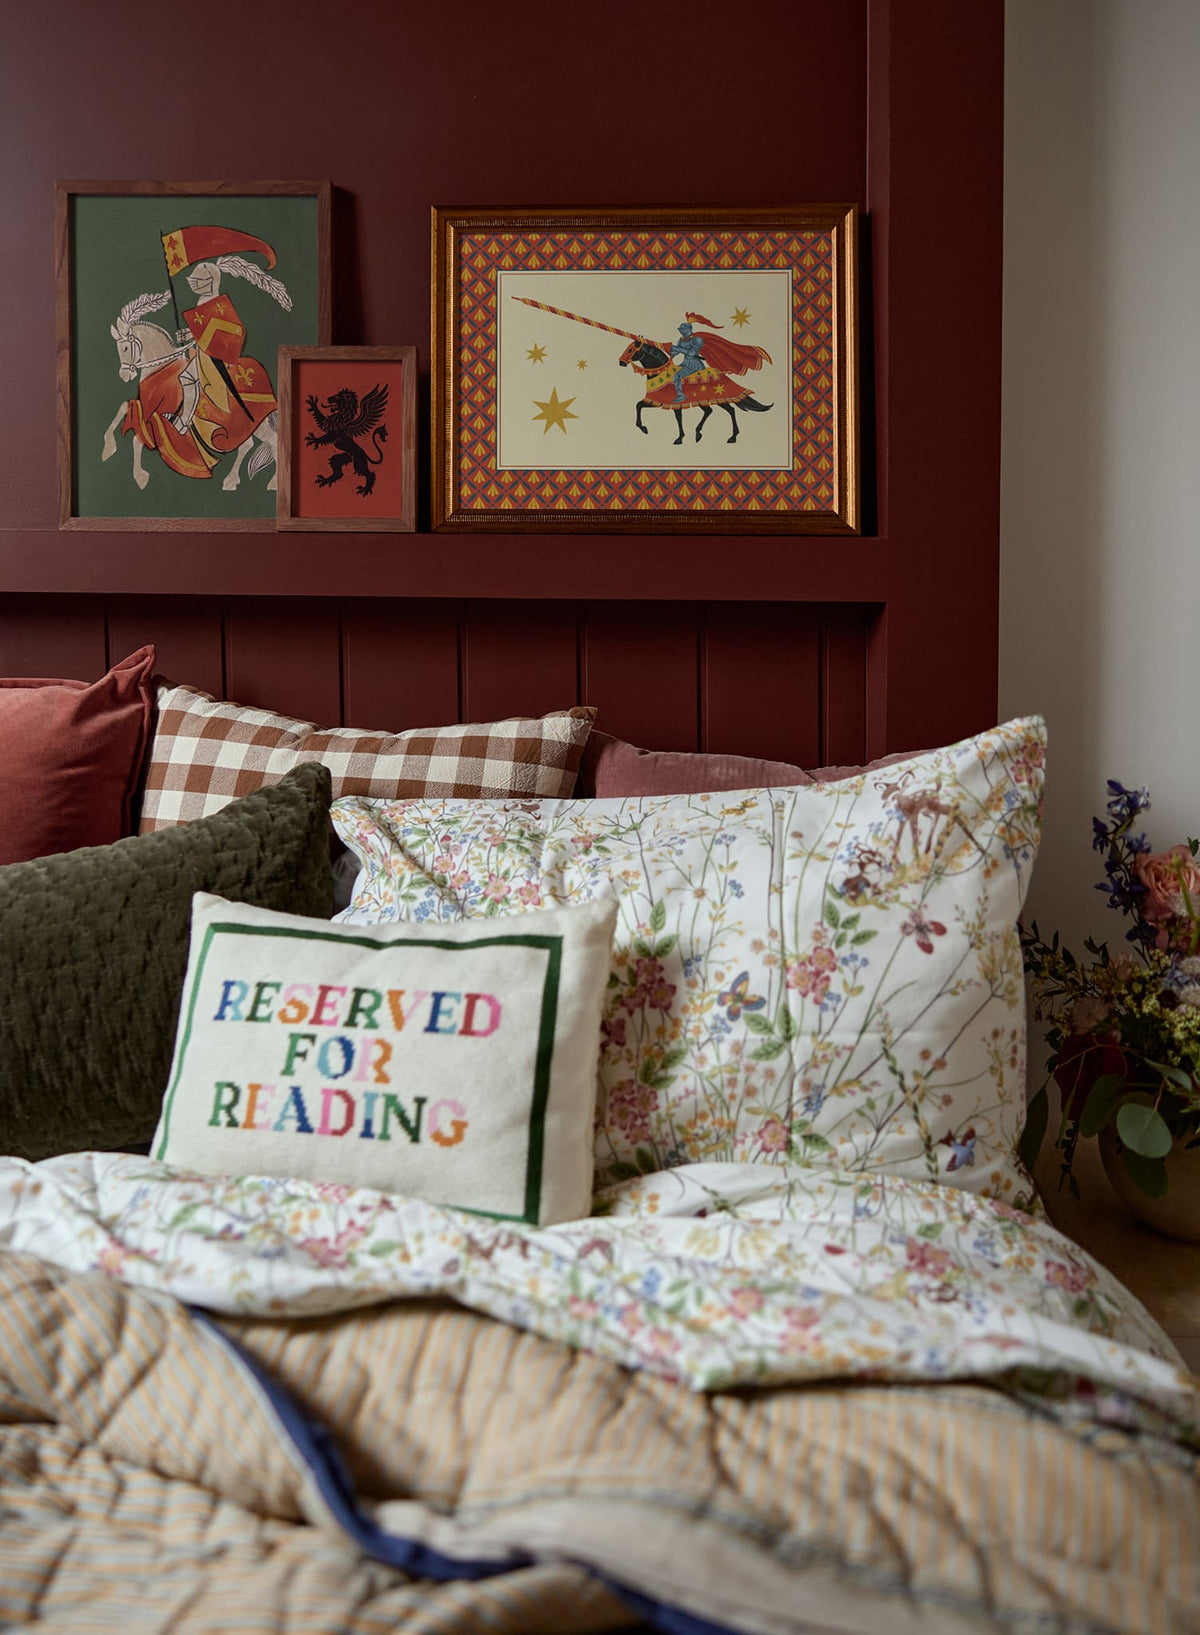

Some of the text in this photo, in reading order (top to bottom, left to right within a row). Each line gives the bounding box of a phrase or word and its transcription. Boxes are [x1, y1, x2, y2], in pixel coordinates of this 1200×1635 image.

[213, 980, 502, 1038] RESERVED
[280, 1032, 393, 1084] FOR
[208, 1081, 469, 1148] READING
